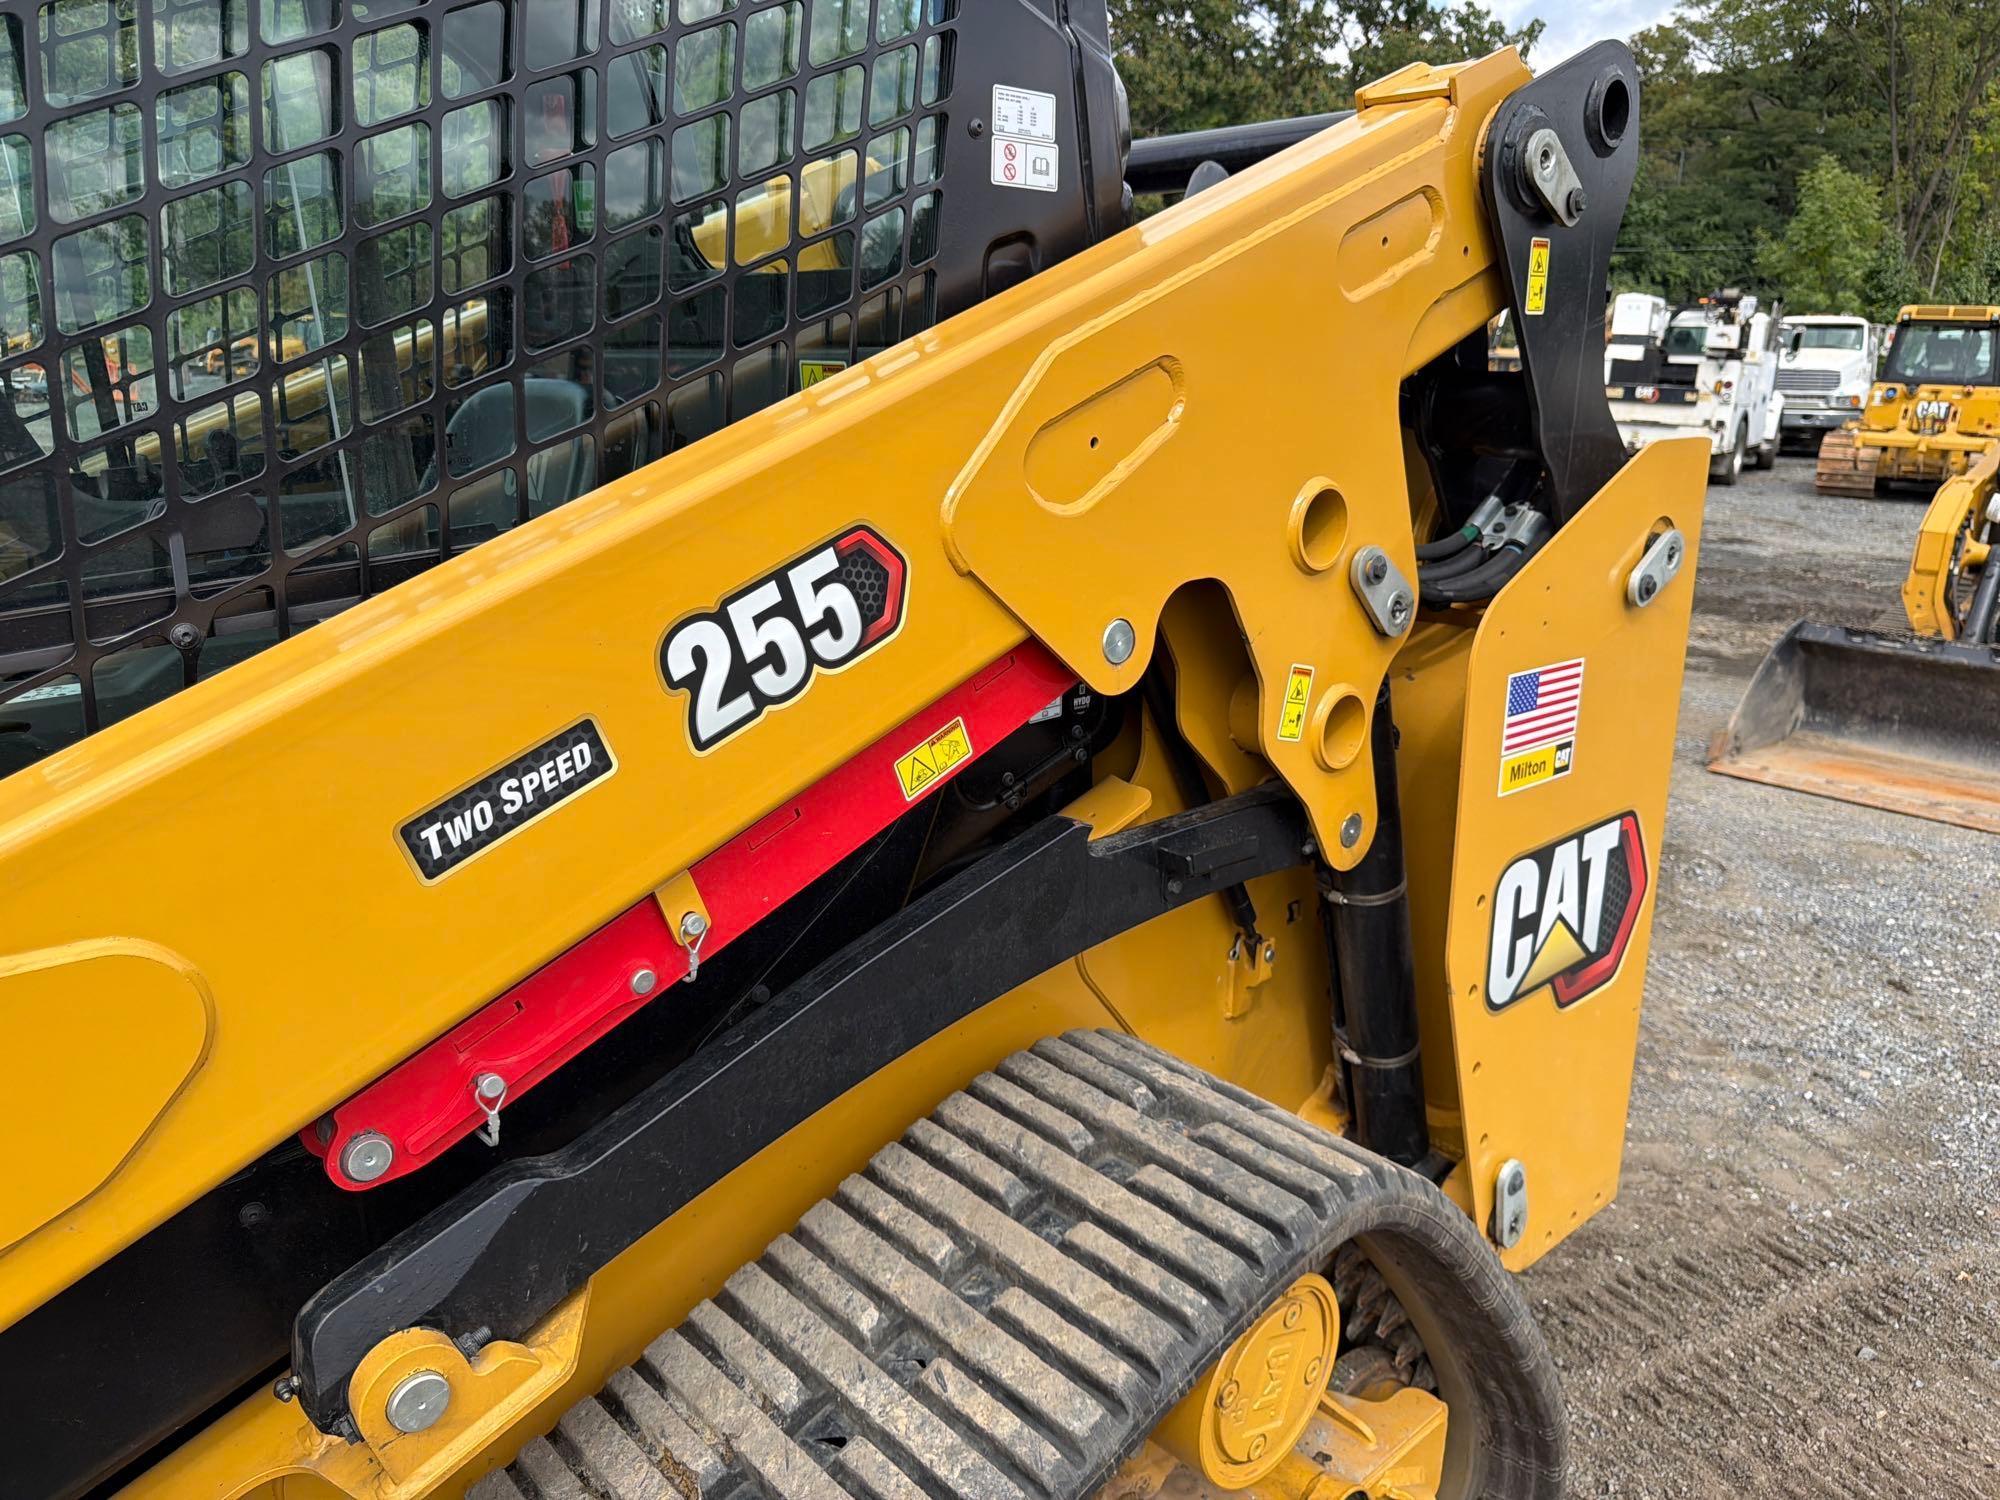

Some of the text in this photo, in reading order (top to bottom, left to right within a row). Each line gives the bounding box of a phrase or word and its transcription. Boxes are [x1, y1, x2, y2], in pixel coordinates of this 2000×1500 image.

[1917, 401, 1950, 420] CAT
[667, 546, 863, 743] 255
[934, 721, 960, 743] WARNING
[1510, 747, 1571, 783] Milton CAT
[420, 742, 592, 860] TWO SPEED
[1488, 819, 1622, 1004] CAT
